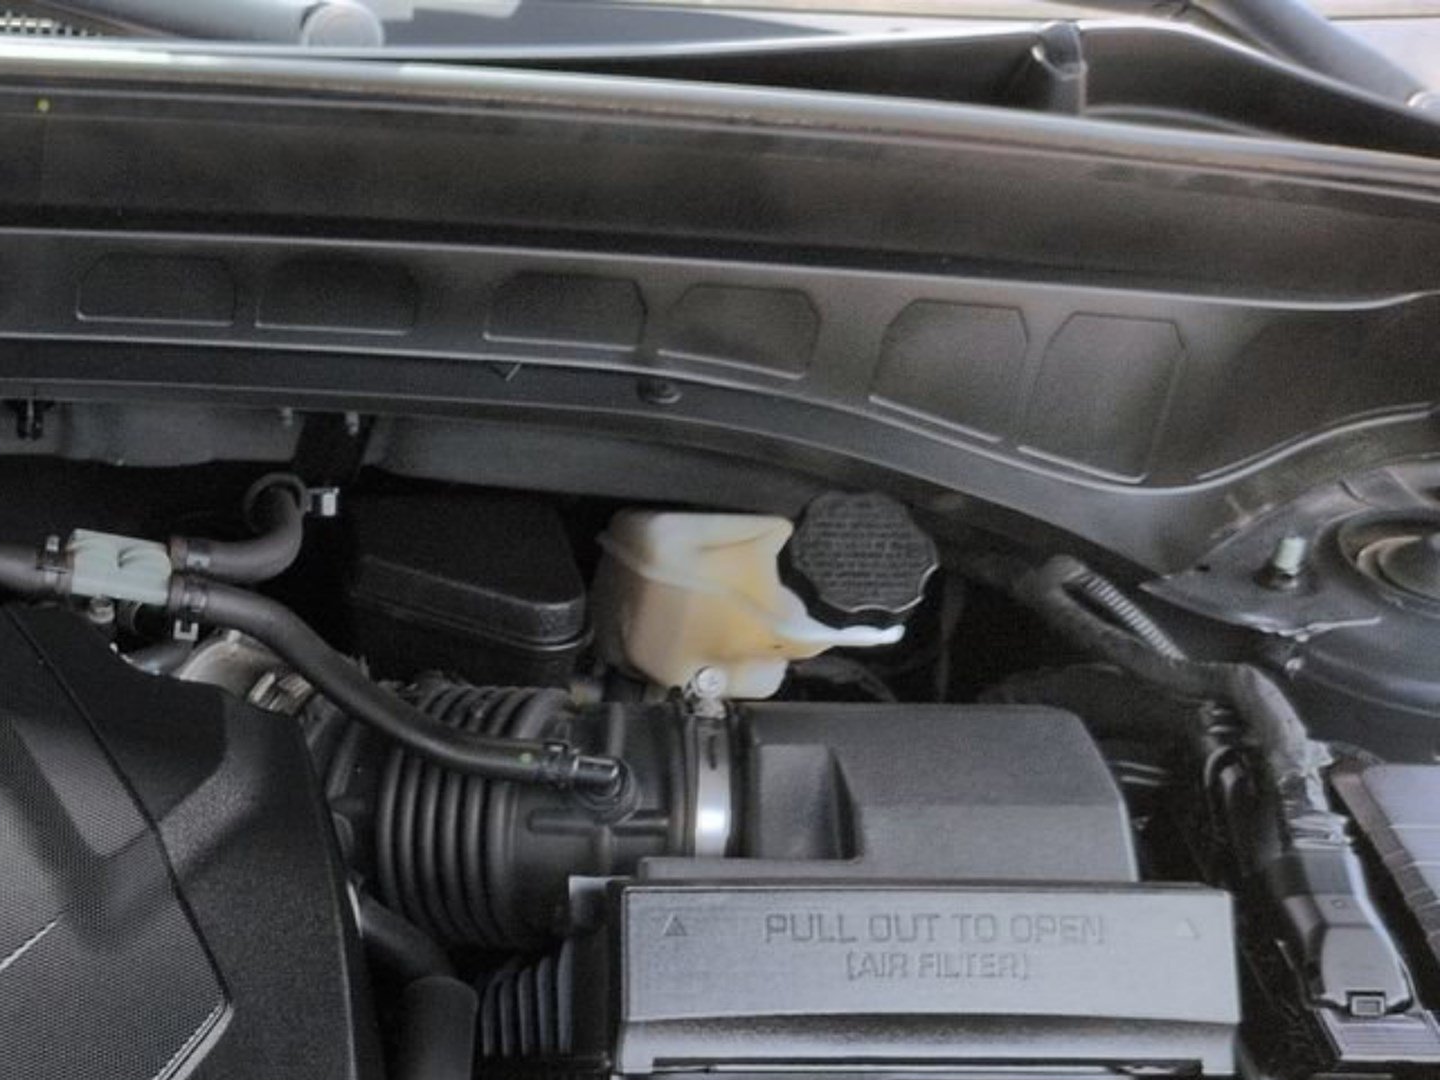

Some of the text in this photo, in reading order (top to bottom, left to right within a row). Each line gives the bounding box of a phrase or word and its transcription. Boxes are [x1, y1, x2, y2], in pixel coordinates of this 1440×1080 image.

[764, 911, 1105, 946] PULL OUT TO OPEN
